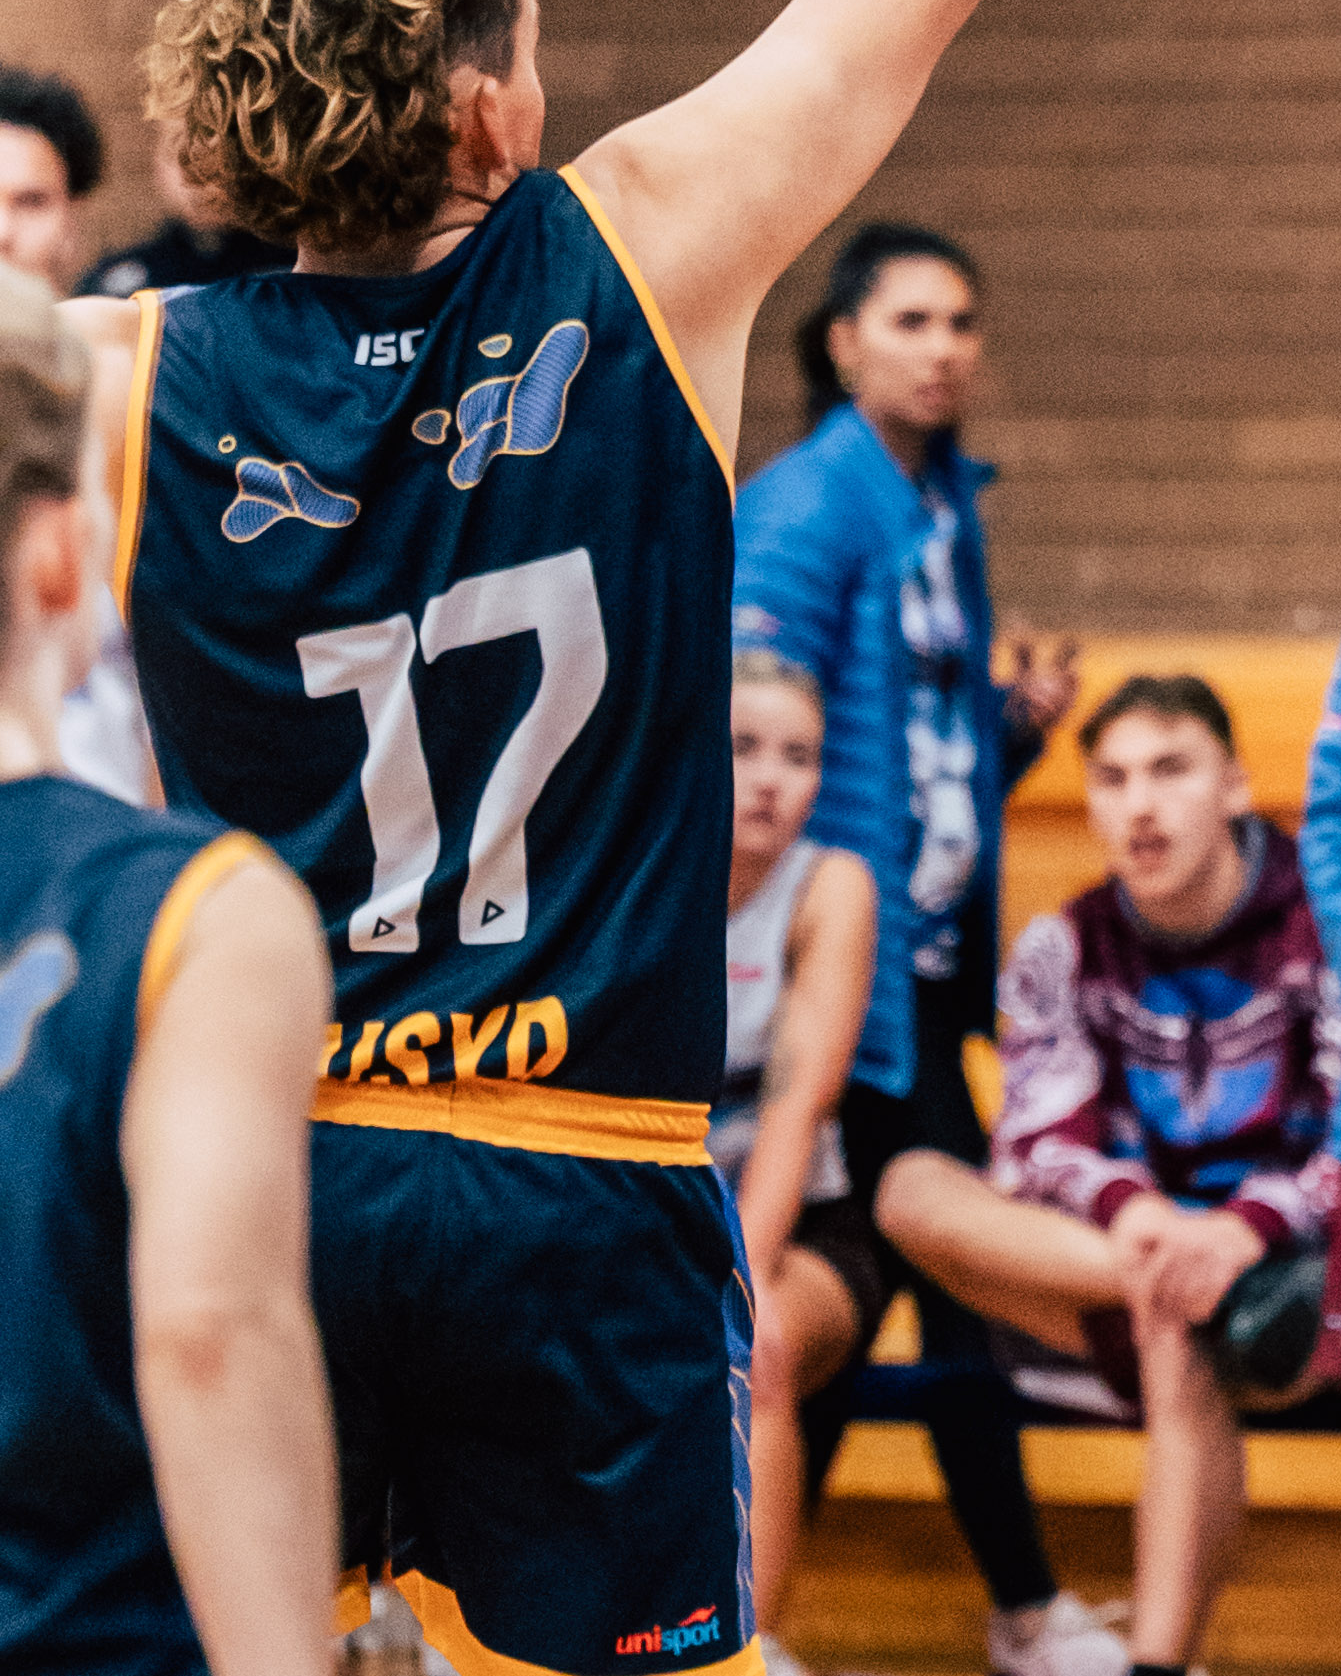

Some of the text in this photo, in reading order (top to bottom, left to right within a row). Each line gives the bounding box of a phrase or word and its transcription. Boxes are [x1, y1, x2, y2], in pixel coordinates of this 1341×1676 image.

[354, 327, 425, 367] ISC
[296, 546, 610, 954] 17
[614, 1614, 721, 1657] unisport
